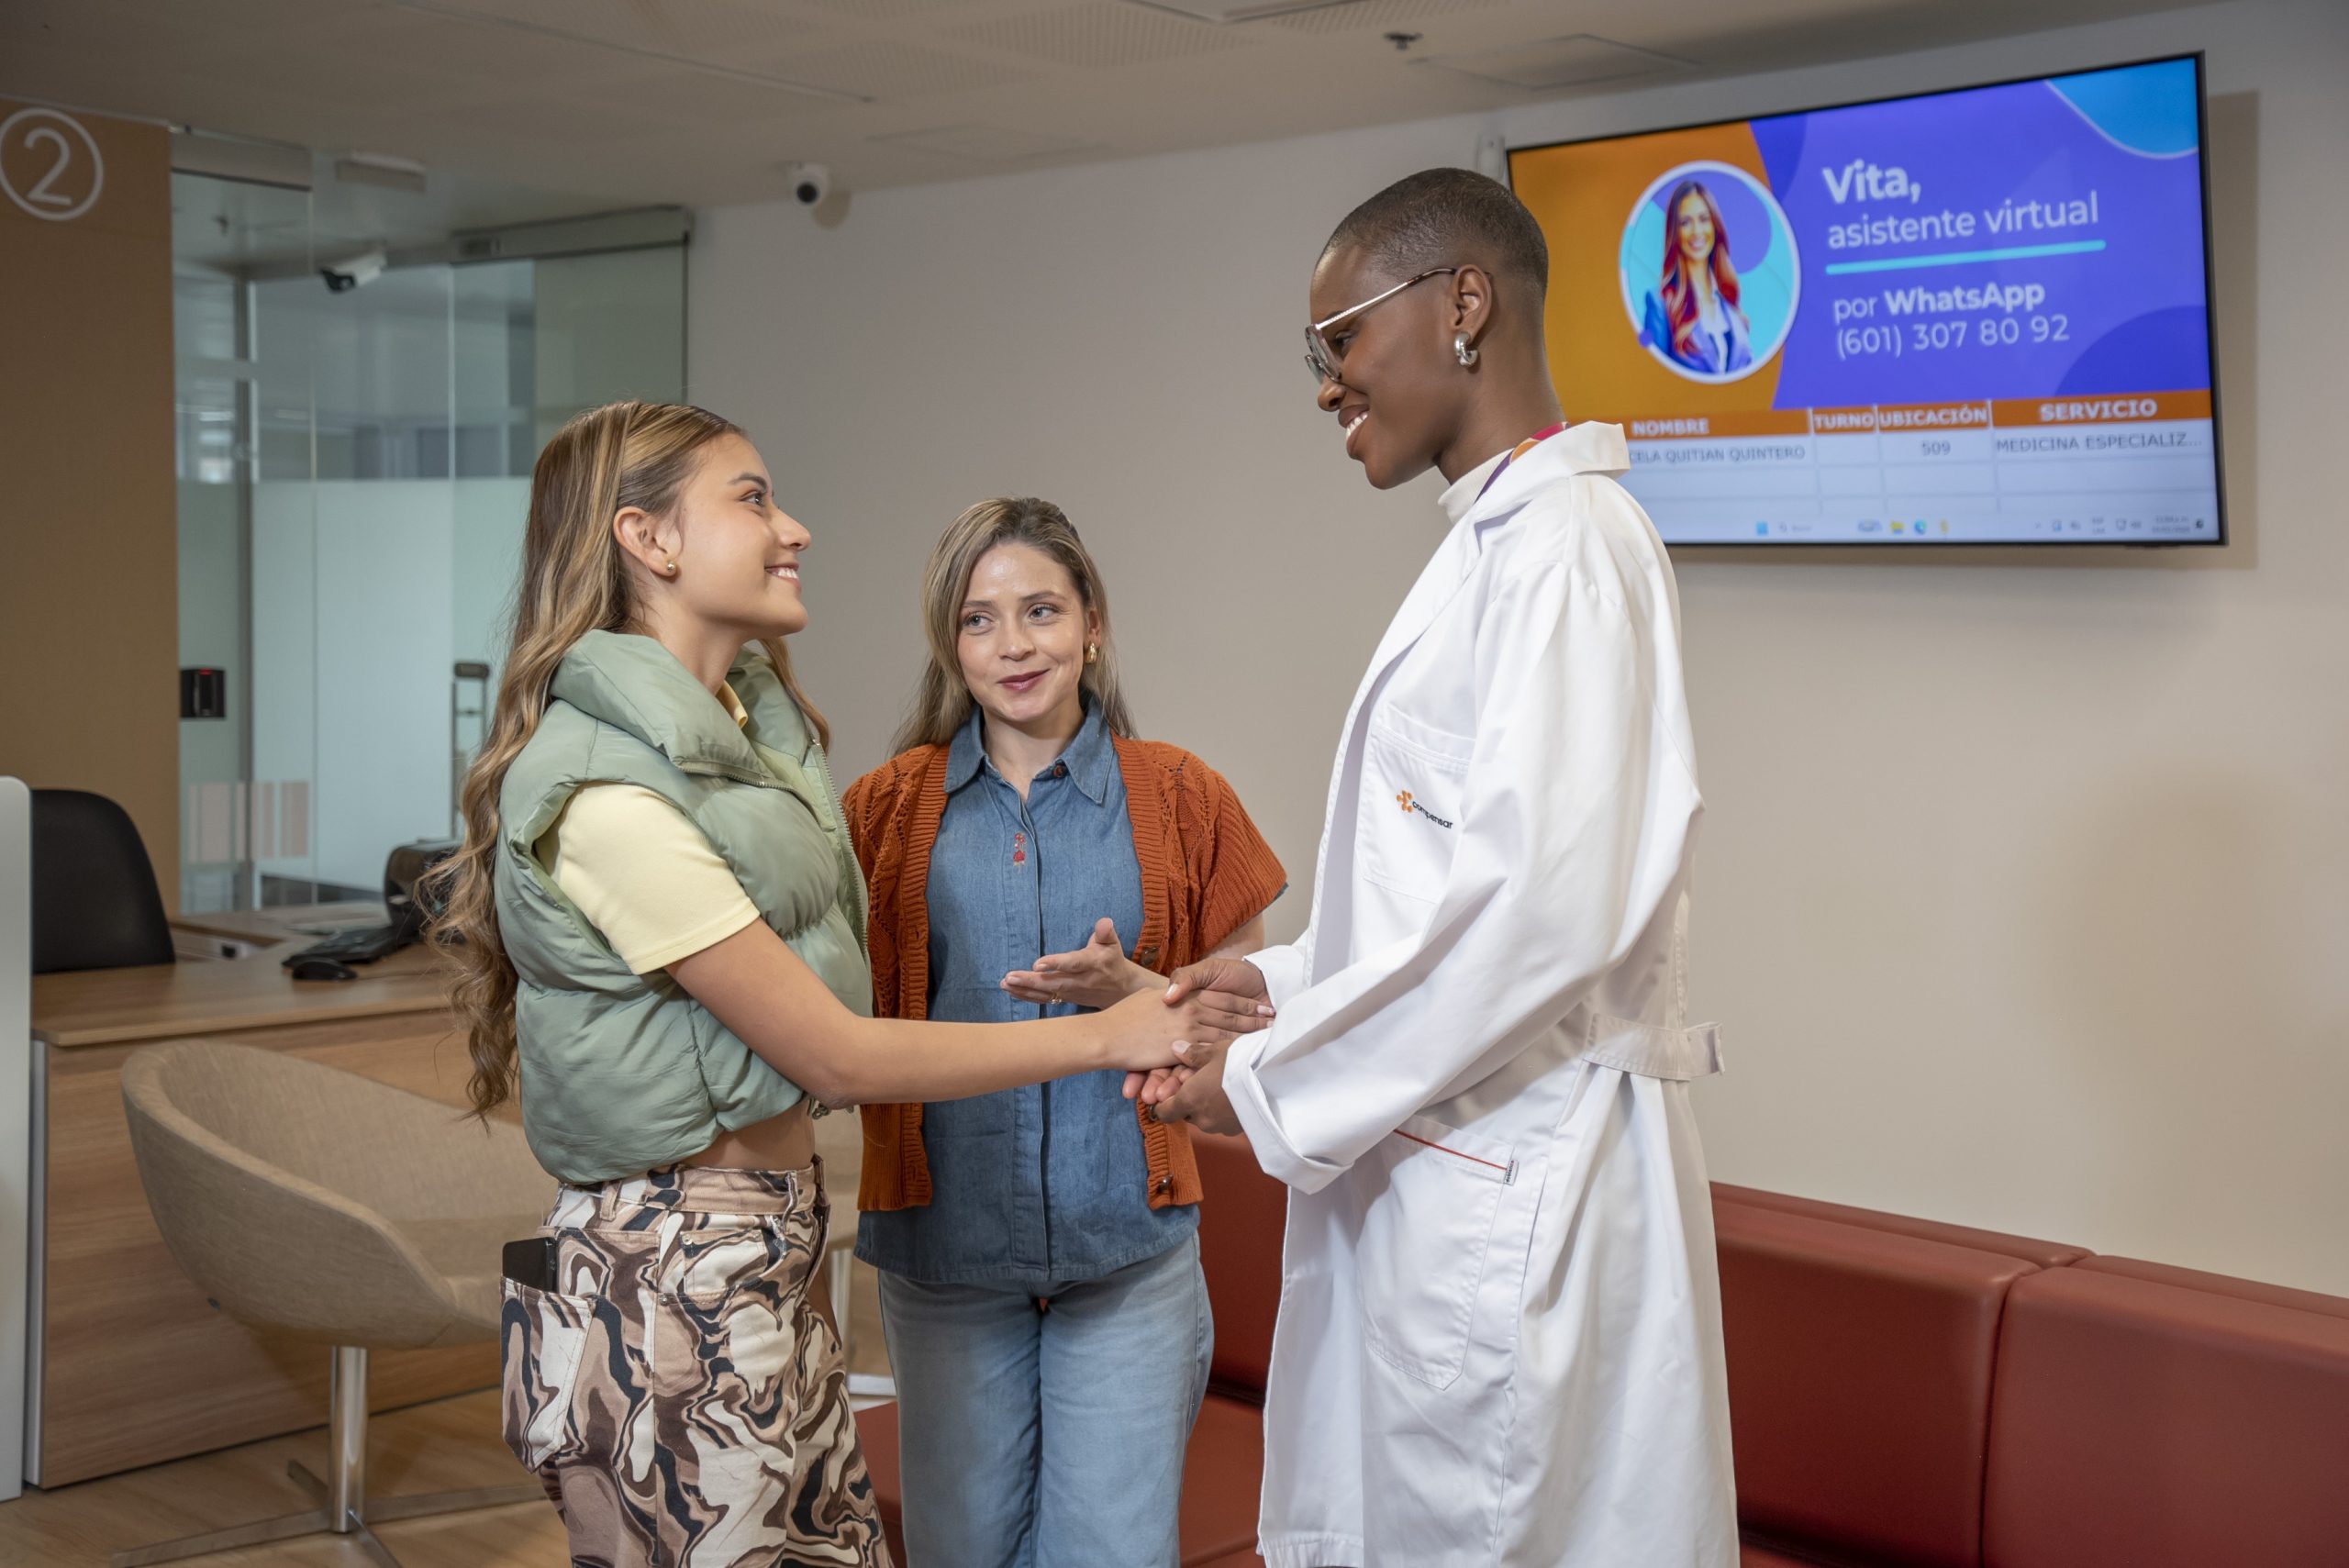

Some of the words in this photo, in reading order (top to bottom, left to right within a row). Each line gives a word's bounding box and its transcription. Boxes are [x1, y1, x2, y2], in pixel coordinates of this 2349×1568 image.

[24, 128, 72, 206] 2
[1822, 159, 1921, 204] Vita,
[1828, 214, 1976, 249] asistente
[1984, 190, 2099, 234] virtual
[1834, 295, 1878, 324] por
[1885, 283, 2045, 316] WhatsApp
[1838, 325, 1901, 360] (601)
[1913, 321, 1967, 350] 307
[1980, 318, 2019, 345] 80
[2031, 315, 2069, 343] 92
[1815, 413, 1875, 428] TURNO
[1879, 406, 1987, 427] UBICACIÓN
[2040, 398, 2157, 422] SERVICIO
[1631, 418, 1709, 436] NOMBRE
[1730, 446, 1806, 462] QUINTERO
[1922, 440, 1951, 456] 509
[1997, 437, 2079, 452] MEDICINA
[1412, 801, 1453, 828] compensar
